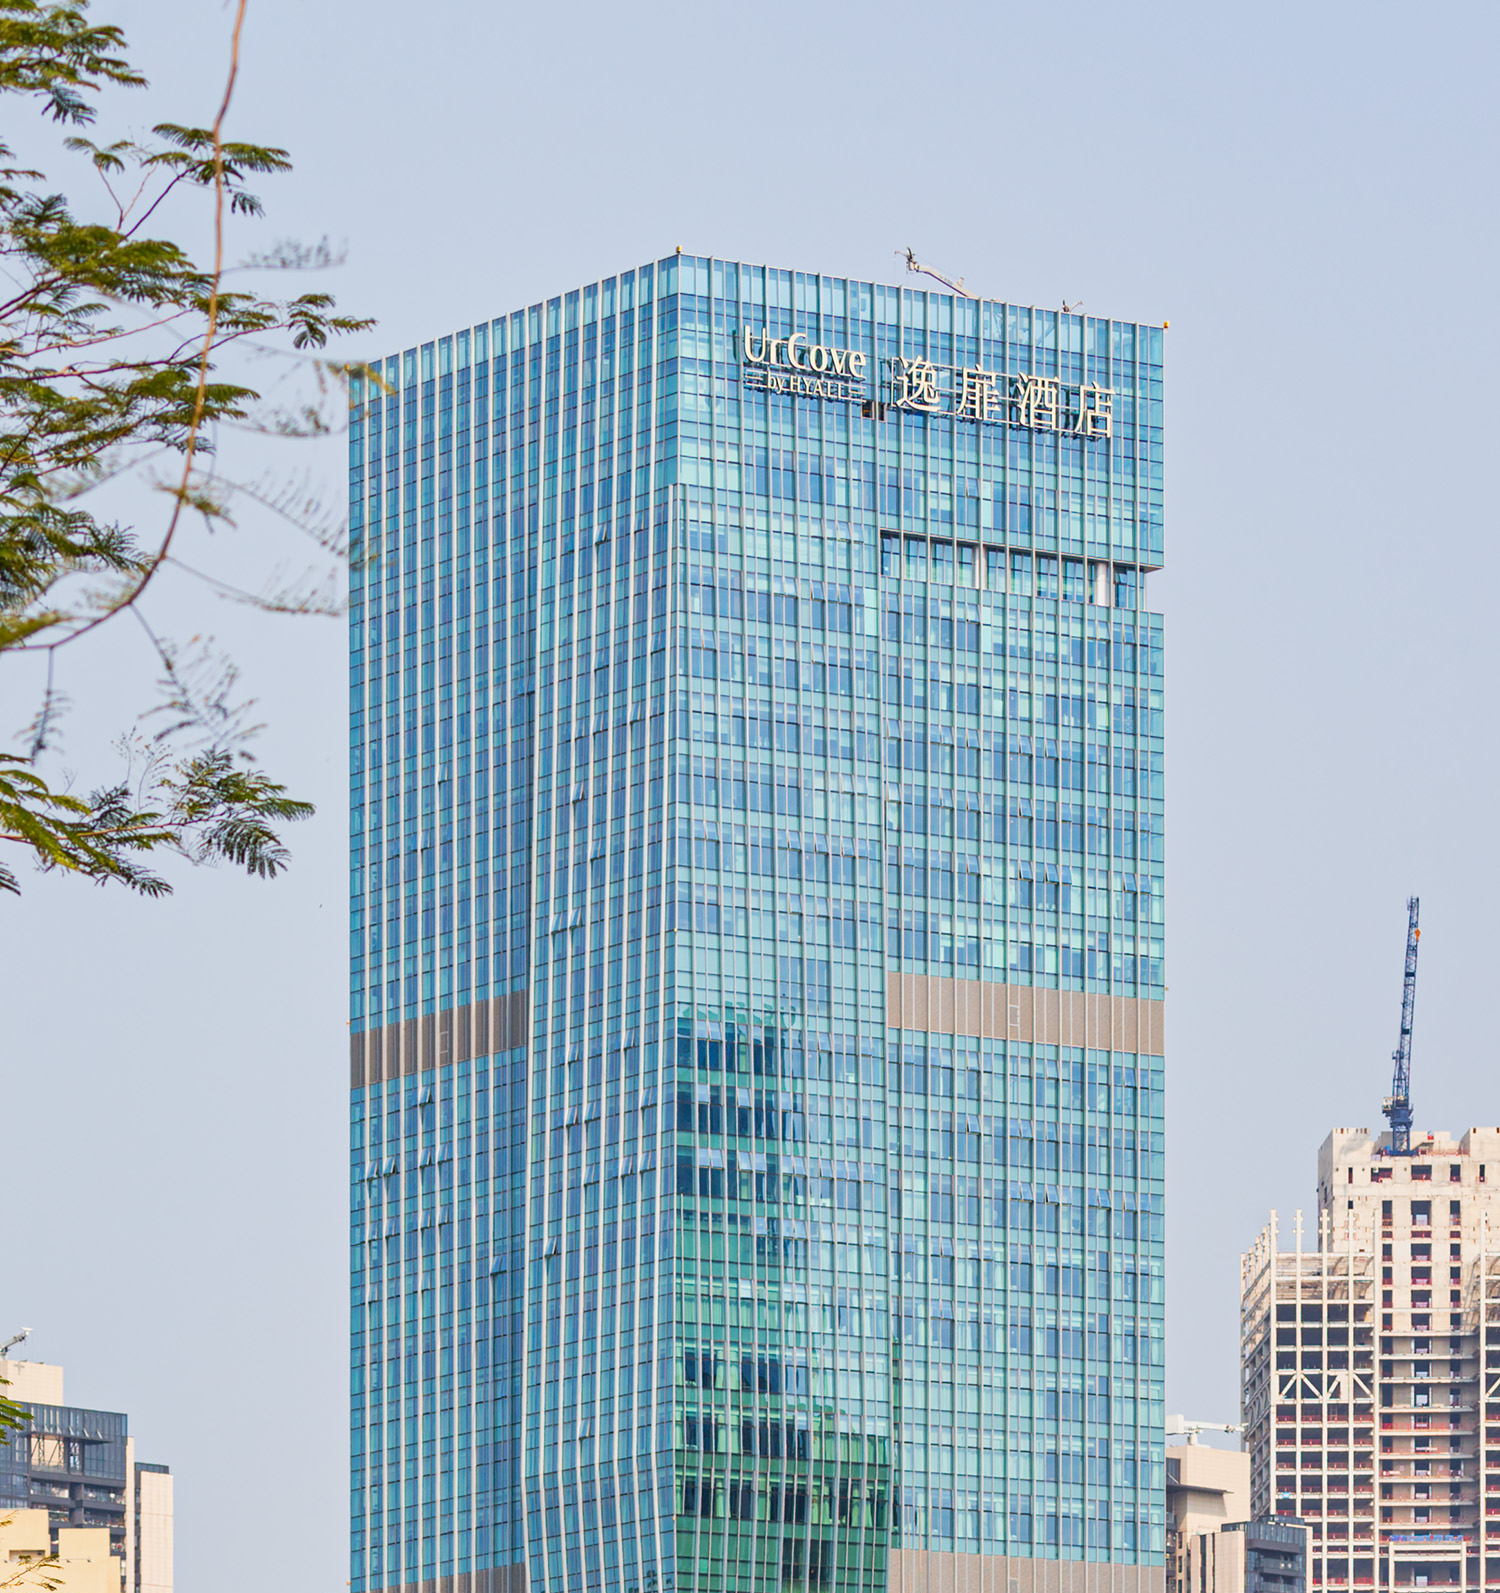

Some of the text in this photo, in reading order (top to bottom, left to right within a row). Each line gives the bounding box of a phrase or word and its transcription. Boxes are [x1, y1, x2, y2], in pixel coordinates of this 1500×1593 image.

[744, 325, 867, 379] UrCove
[767, 366, 846, 400] by HYATT
[895, 355, 1116, 438] 逸扉酒店
